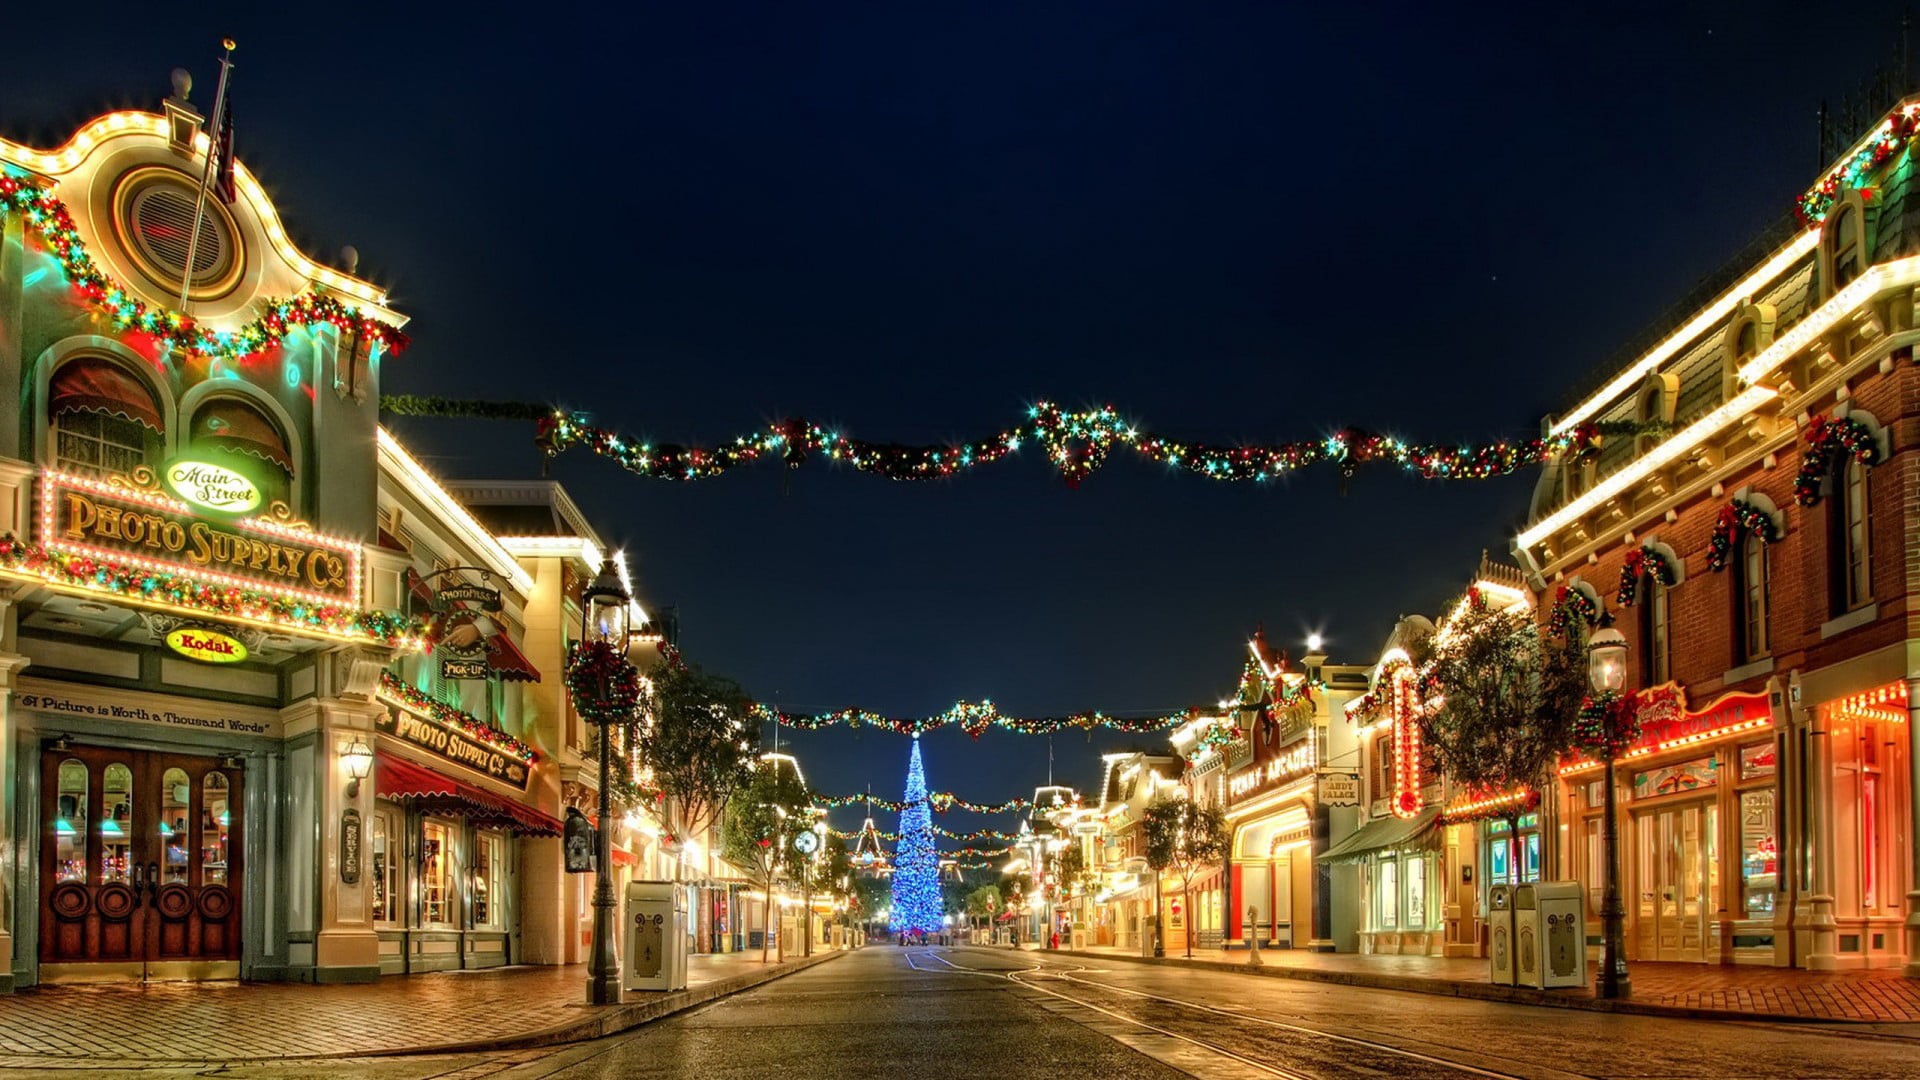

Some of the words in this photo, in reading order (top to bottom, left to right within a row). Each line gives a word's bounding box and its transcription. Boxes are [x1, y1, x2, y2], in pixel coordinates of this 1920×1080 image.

[173, 466, 243, 487] Main
[196, 484, 253, 506] Street
[67, 493, 185, 552] PHOTO
[187, 522, 304, 578] SUPPLY
[181, 634, 234, 655] Kodak
[446, 663, 484, 675] PICK-UP
[41, 697, 94, 714] Picture
[98, 705, 109, 716] is
[111, 705, 149, 721] Worth
[152, 712, 161, 722] a
[163, 712, 225, 729] Thousand
[1681, 704, 1745, 737] CORNER
[395, 709, 447, 749] PHOTO
[447, 734, 490, 768] SUPPLY
[1322, 791, 1356, 799] PALACE
